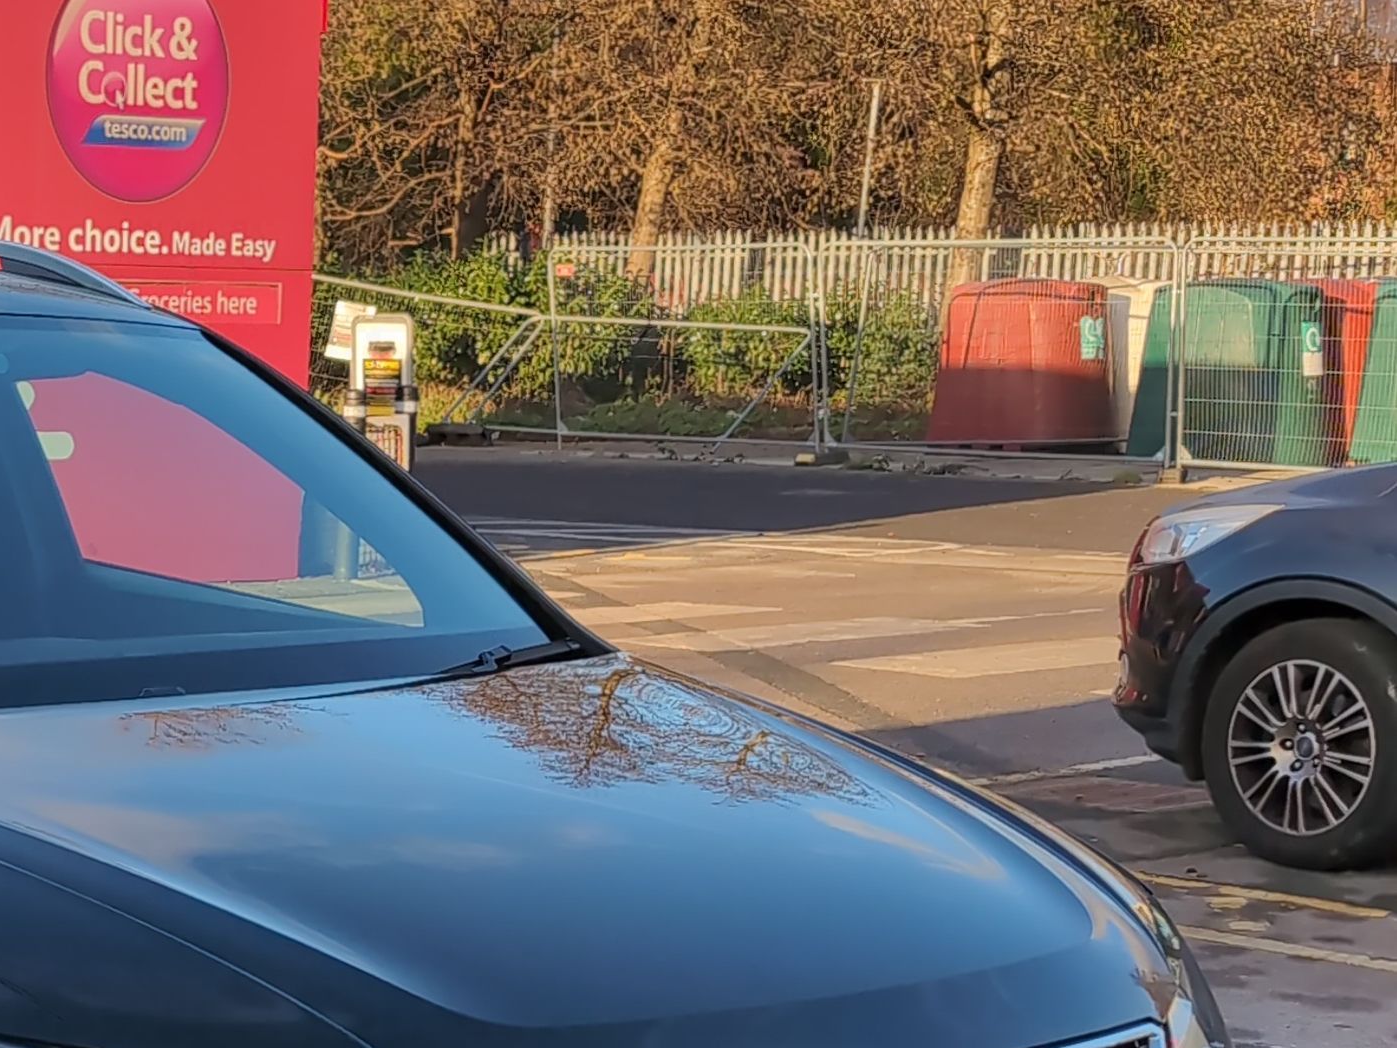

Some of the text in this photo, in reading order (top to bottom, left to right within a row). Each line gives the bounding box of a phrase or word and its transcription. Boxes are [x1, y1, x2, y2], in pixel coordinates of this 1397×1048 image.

[80, 9, 198, 60] Click &
[78, 60, 198, 110] Collect
[104, 120, 187, 142] tesco.com
[68, 219, 169, 255] choice.
[172, 231, 227, 256] Made
[230, 233, 276, 263] Easy
[217, 290, 257, 314] here
